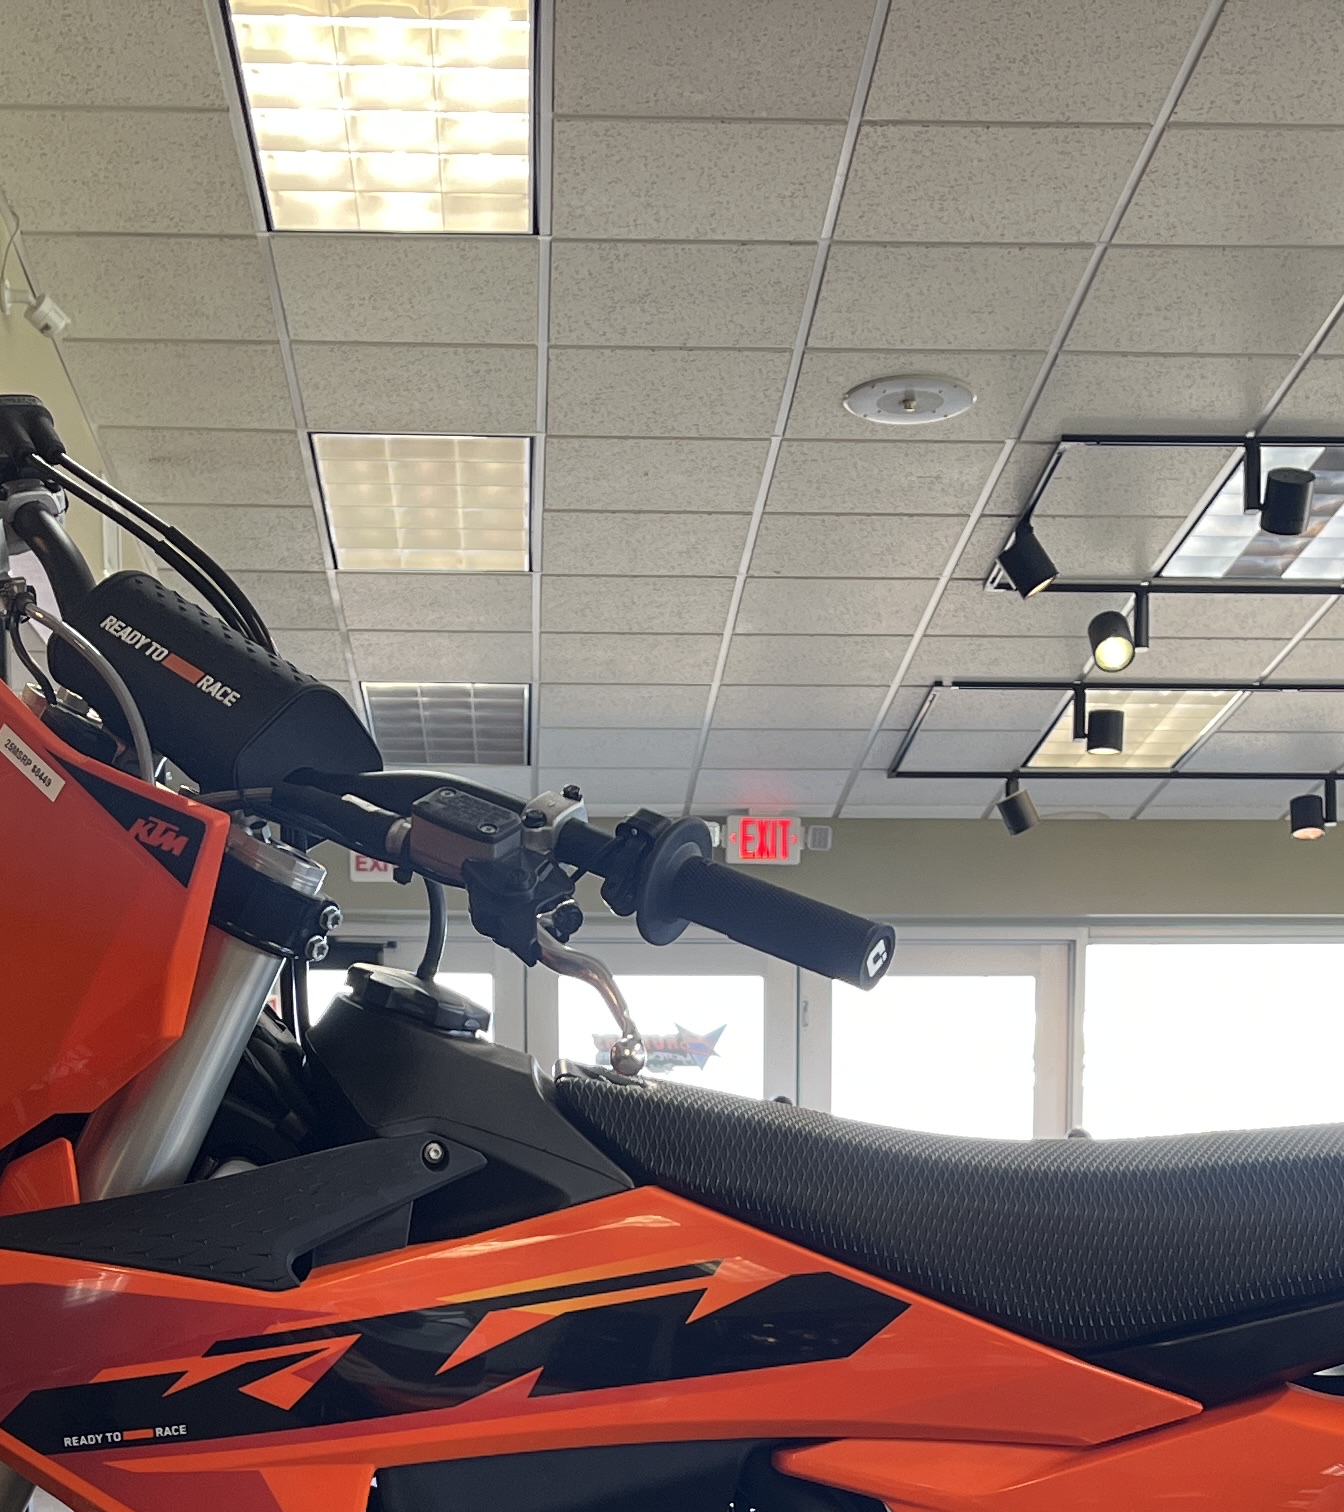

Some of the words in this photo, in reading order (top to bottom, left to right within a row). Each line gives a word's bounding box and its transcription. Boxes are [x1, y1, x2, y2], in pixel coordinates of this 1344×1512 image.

[99, 615, 152, 650] READY
[144, 641, 169, 662] TO
[196, 674, 241, 707] RACE
[128, 816, 190, 857] KTM
[738, 817, 792, 860] EXIT
[355, 855, 389, 872] EXI
[63, 1434, 103, 1448] READY
[105, 1431, 121, 1443] TO
[155, 1425, 187, 1438] RACE
